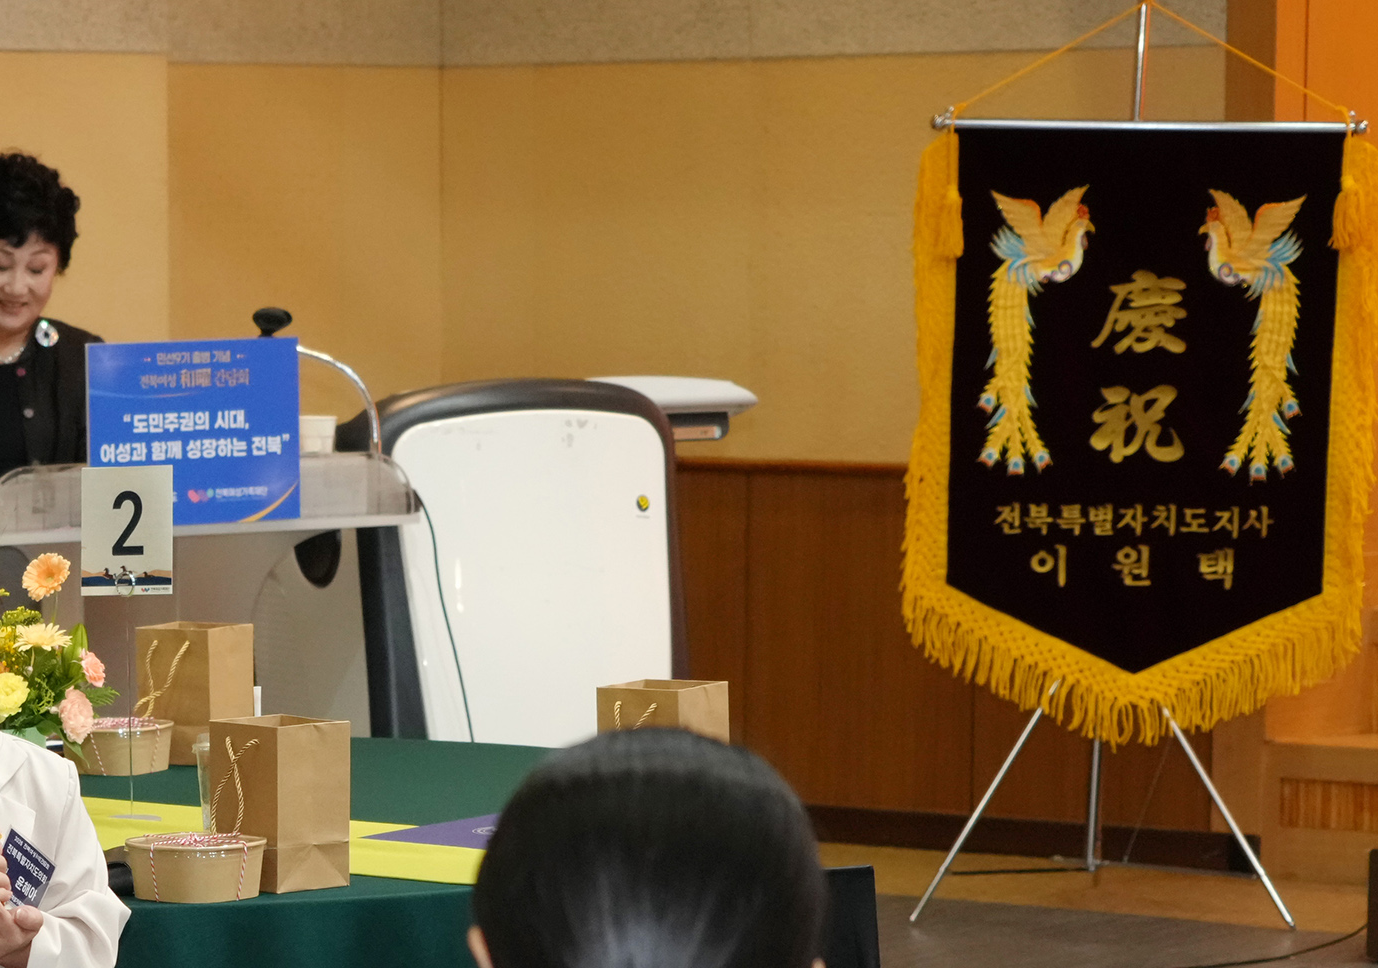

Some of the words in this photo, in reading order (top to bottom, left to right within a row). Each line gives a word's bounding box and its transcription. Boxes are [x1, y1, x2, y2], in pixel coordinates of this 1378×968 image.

[214, 409, 250, 431] 시대,
[100, 442, 147, 463] 여성과
[151, 440, 183, 461] 함께
[186, 437, 248, 459] 성장하는
[112, 490, 145, 556] 2
[994, 502, 1274, 539] 전북특별자치도지사
